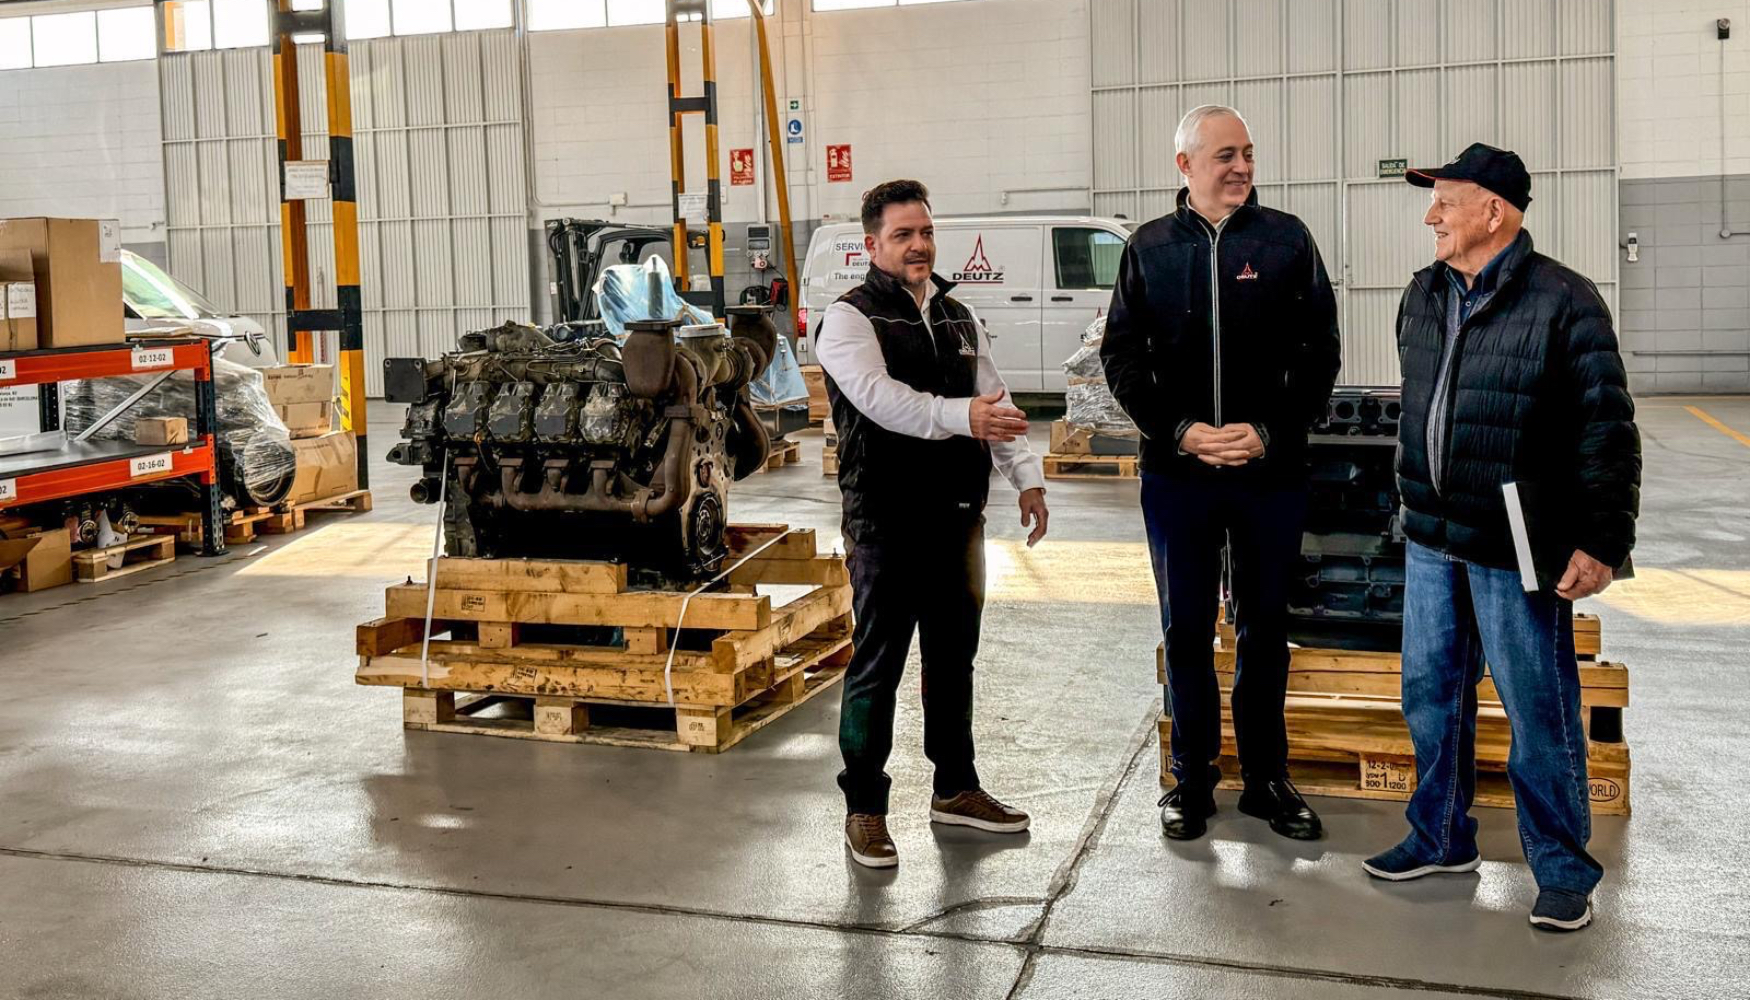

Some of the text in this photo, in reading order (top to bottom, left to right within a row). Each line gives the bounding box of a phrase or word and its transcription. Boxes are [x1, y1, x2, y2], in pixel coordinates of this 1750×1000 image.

[835, 242, 866, 251] SERVI
[952, 272, 1004, 281] DEUTZ
[139, 353, 166, 363] 02-12-02
[137, 459, 165, 471] 02-16-02
[1380, 771, 1388, 789] 1
[1389, 781, 1407, 790] 1200
[1588, 783, 1616, 798] ORLD
